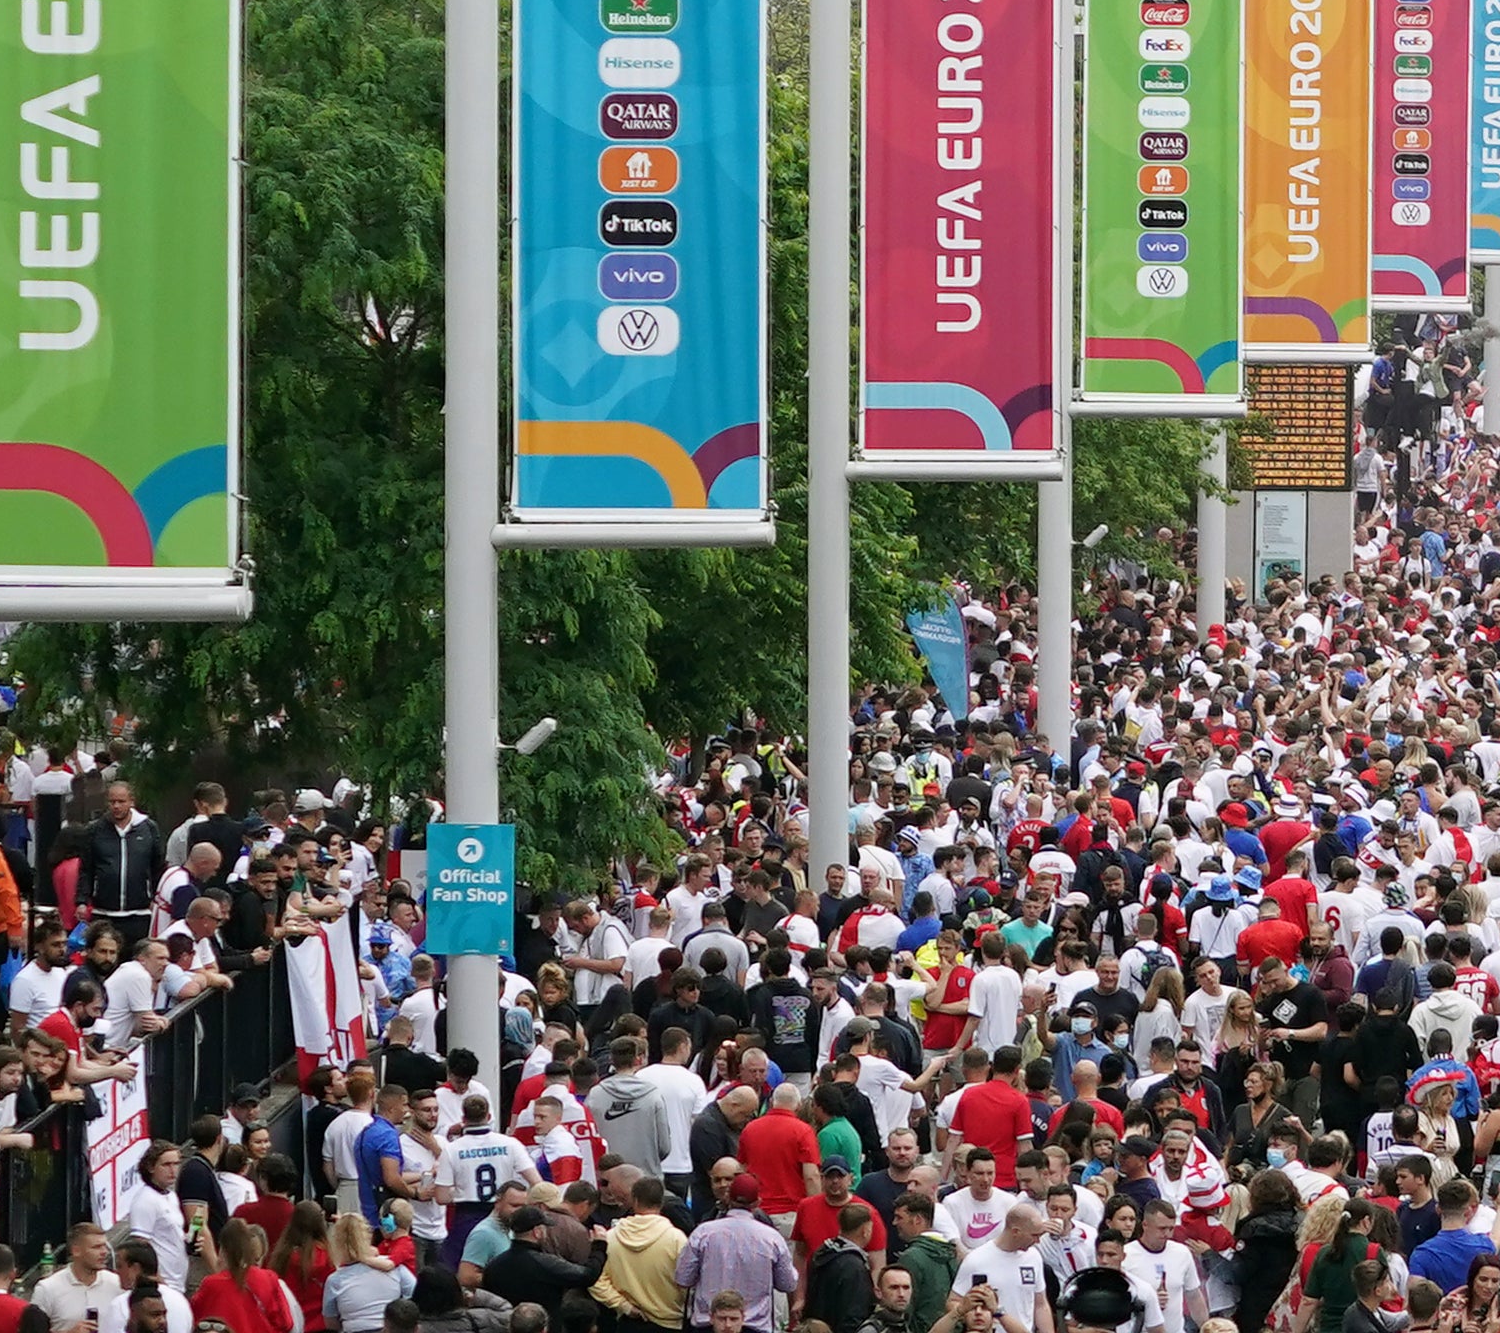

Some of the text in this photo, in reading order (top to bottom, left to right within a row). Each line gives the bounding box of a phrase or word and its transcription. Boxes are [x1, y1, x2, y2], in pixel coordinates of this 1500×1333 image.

[608, 12, 672, 26] Heineken
[1146, 39, 1183, 51] FedEx
[1400, 36, 1427, 46] FedEx
[605, 56, 674, 70] Hisense
[937, 13, 985, 171] EURO
[1289, 42, 1322, 156] EURO
[607, 103, 671, 122] QATAR
[1142, 108, 1186, 117] Hisense
[622, 119, 672, 132] AIRWAYS
[1143, 137, 1184, 151] QATAR
[621, 179, 657, 188] JUST EAT
[19, 74, 103, 351] UEFA
[1152, 209, 1185, 220] TikTok
[1289, 159, 1321, 262] UEFA
[622, 217, 673, 233] TikTok
[1146, 241, 1180, 253] vivo
[936, 180, 983, 333] UEFA
[613, 268, 665, 284] vivo
[440, 869, 502, 884] Official
[432, 888, 508, 905] Fan Shop
[1325, 906, 1341, 932] 6
[609, 1101, 634, 1112] NIKE
[458, 1146, 508, 1160] GASCOIGNE
[475, 1163, 496, 1202] 8
[972, 1213, 993, 1225] NIKE
